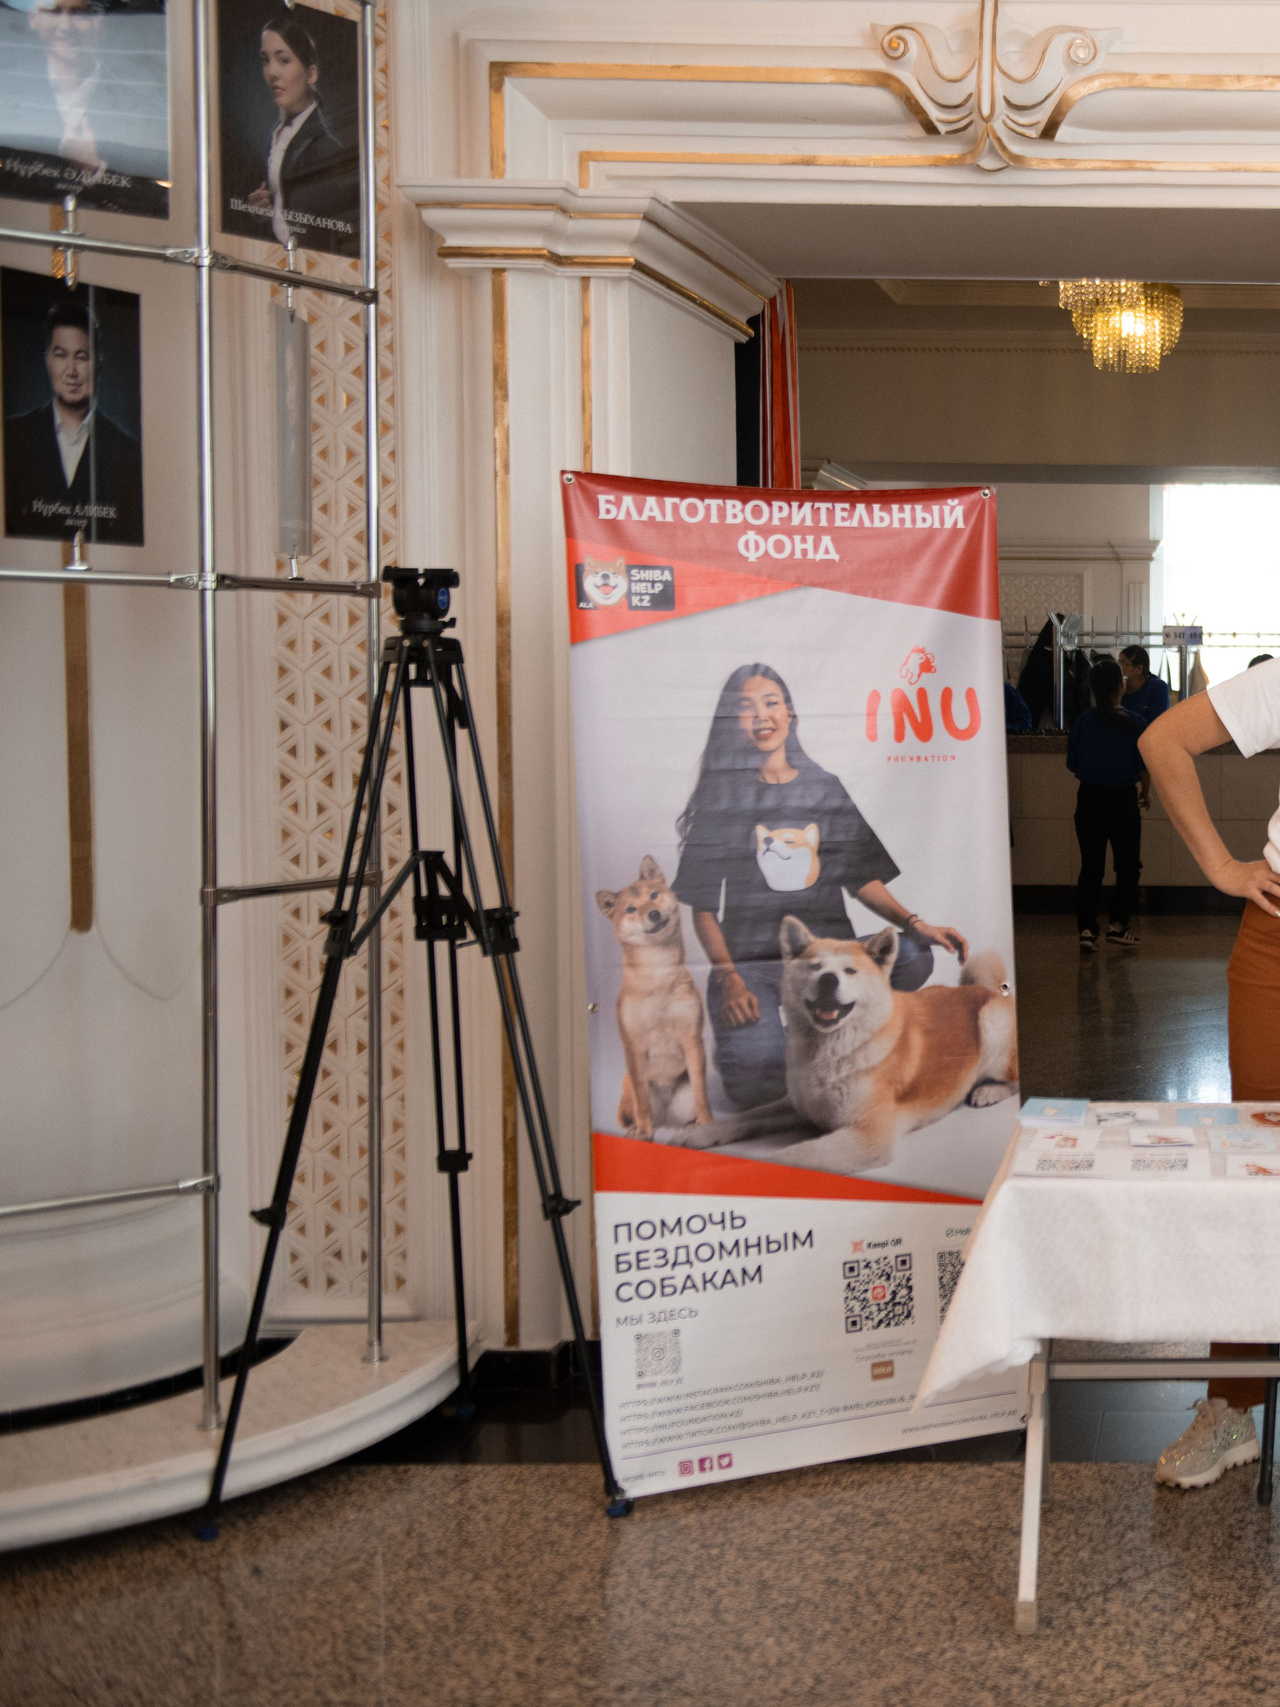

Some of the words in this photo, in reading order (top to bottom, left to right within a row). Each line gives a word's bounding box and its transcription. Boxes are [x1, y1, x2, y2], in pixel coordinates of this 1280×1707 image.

[597, 494, 966, 529] БЛАГОТВОРИТЕЛЬНЫЙ
[737, 530, 840, 562] ФОНД
[630, 569, 672, 581] SHIBA
[631, 582, 664, 594] HELP
[631, 595, 651, 607] KZ
[865, 686, 982, 744] INU
[887, 754, 957, 764] FOUNDATION
[613, 1210, 747, 1245] ПОМОЧЬ
[614, 1229, 814, 1275] БЕЗДОМНЫМ
[614, 1264, 763, 1303] СОБАКАМ
[615, 1313, 643, 1328] МЫ
[647, 1307, 699, 1325] ЗДЕСЬ
